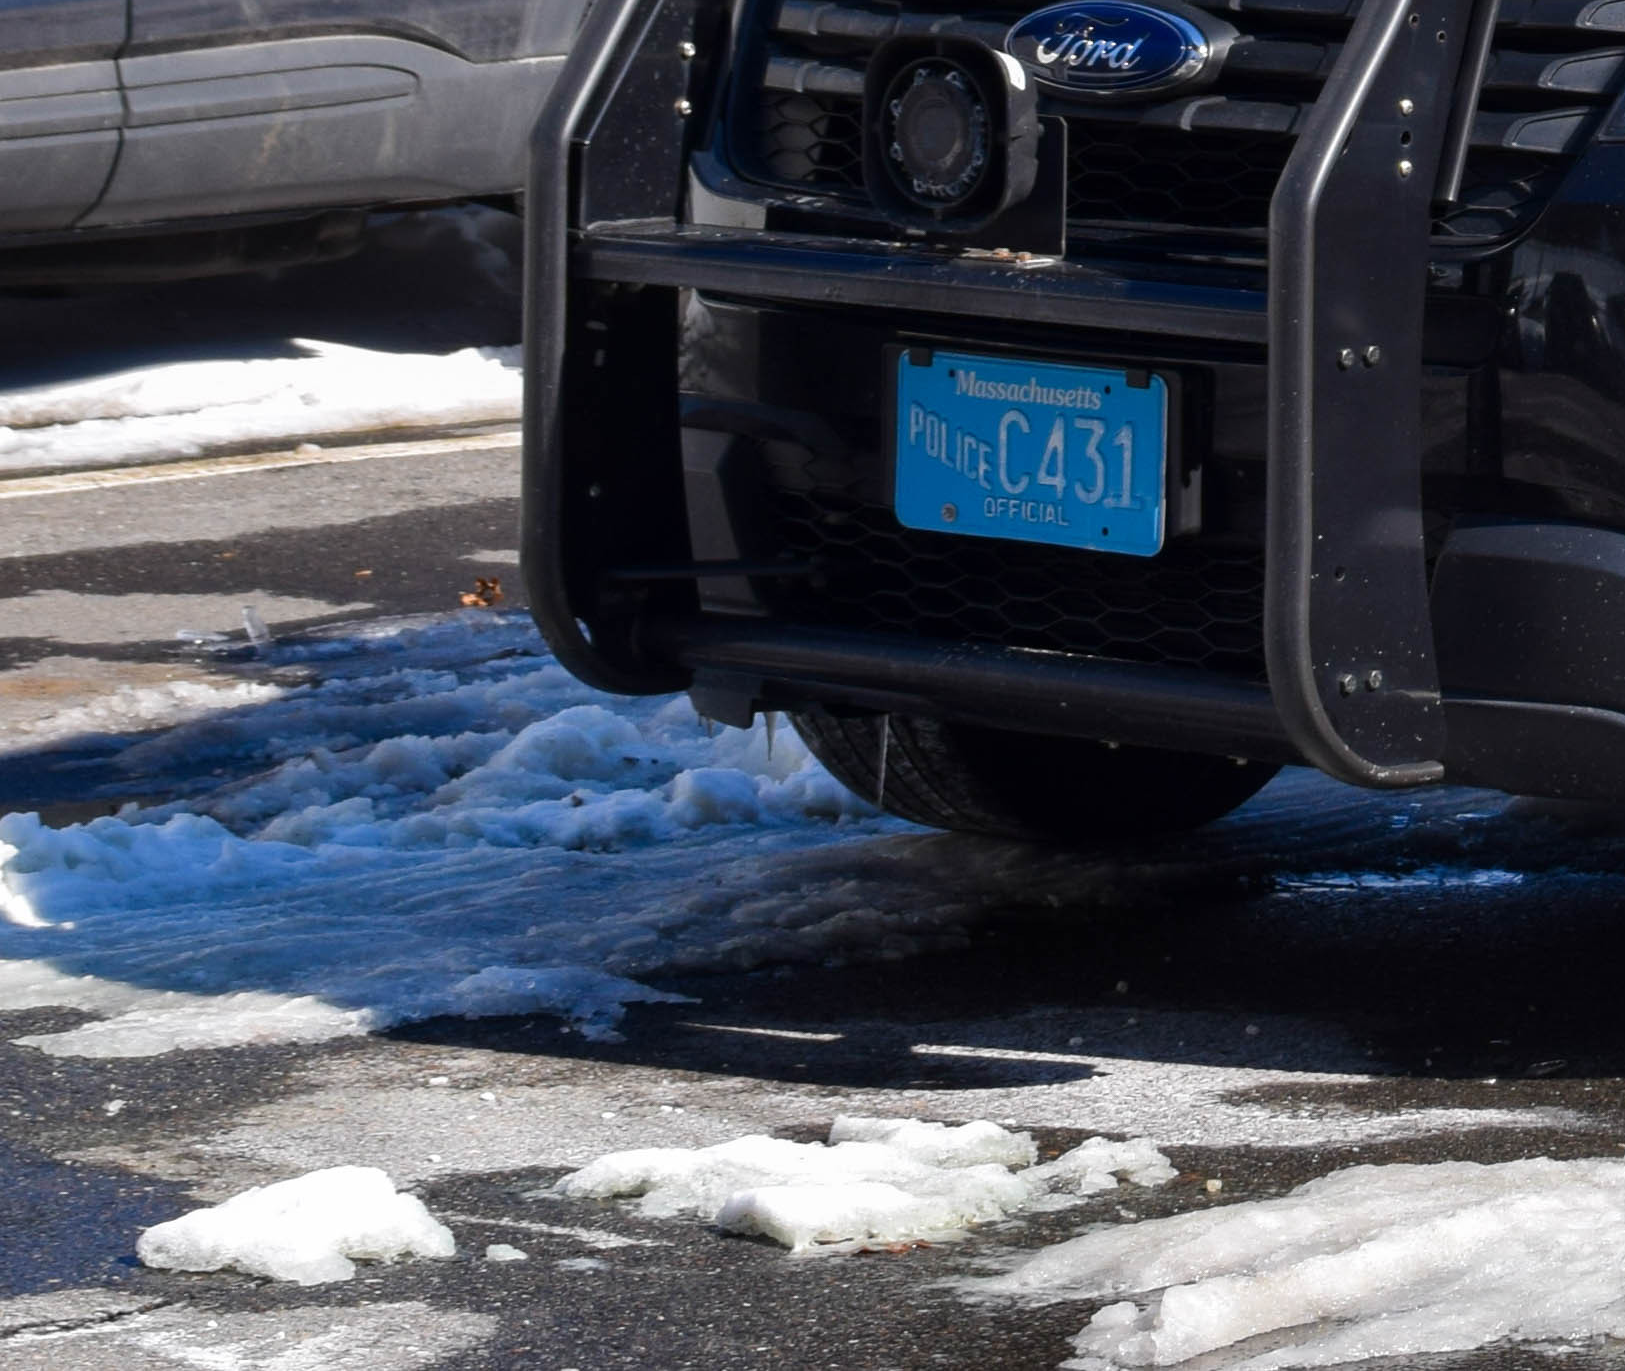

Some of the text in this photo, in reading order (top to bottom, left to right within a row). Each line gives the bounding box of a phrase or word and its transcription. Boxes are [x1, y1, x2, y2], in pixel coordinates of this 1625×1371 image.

[1036, 16, 1144, 74] Ford
[954, 369, 1103, 412] Massachusetts
[909, 404, 1145, 511] POLICE C431
[983, 495, 1070, 527] OFFICIAL
